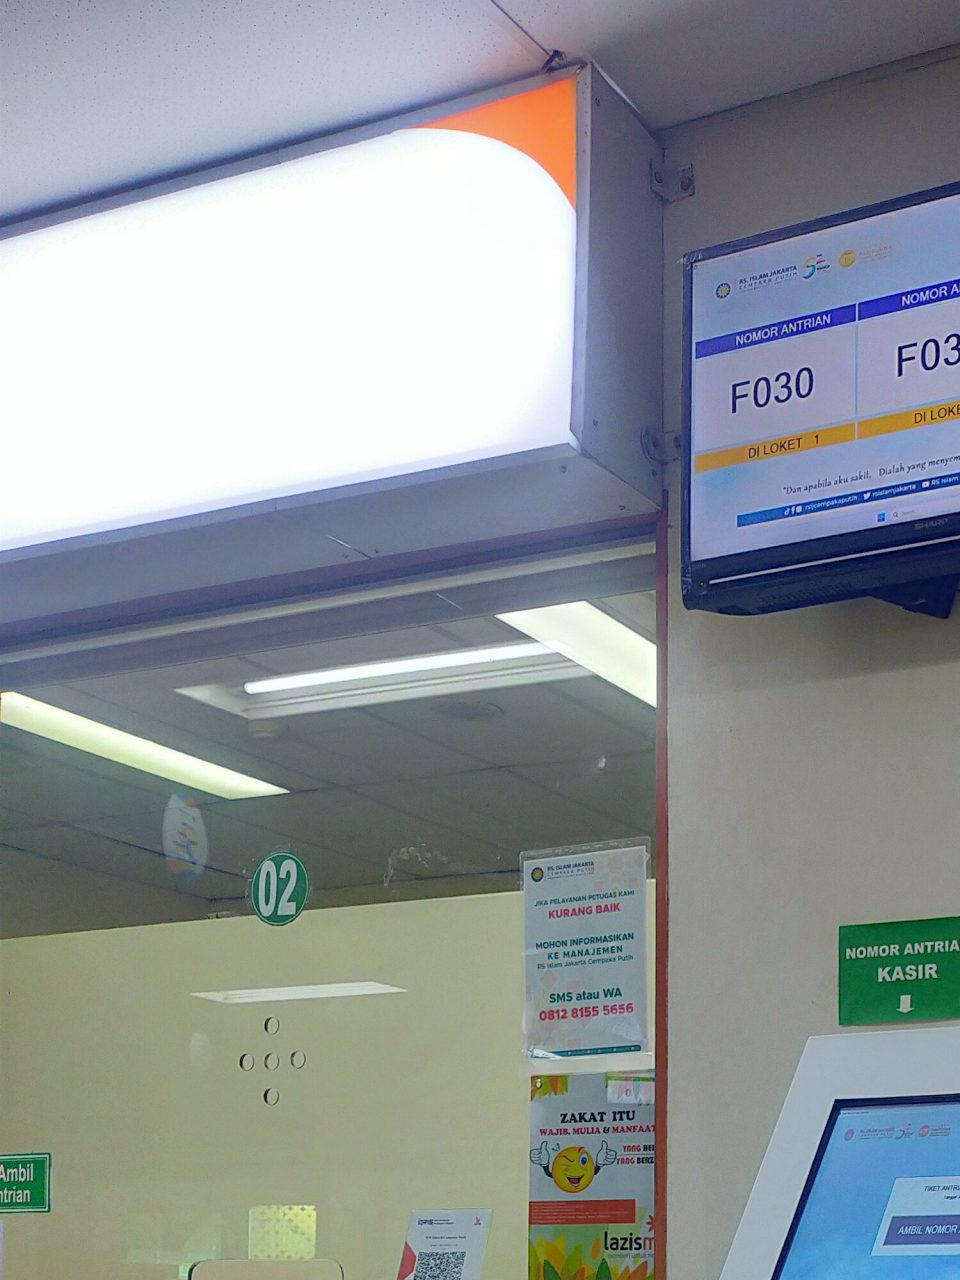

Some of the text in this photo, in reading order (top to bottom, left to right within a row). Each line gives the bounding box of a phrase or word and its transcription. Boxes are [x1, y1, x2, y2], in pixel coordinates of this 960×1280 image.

[769, 265, 797, 277] JAKARTA
[901, 285, 946, 306] NOMOR
[735, 314, 831, 345] NOMOR ANTRIAN
[731, 367, 814, 414] F030
[914, 412, 927, 424] DI
[748, 434, 820, 459] DI LOKET 1
[803, 478, 832, 494] apabila
[833, 475, 849, 486] aku
[879, 464, 905, 477] Dialah
[906, 461, 926, 474] yang
[931, 477, 940, 486] RS
[941, 474, 959, 484] Islam
[556, 863, 571, 871] ISLAM
[572, 861, 594, 869] JAKARTA
[258, 859, 297, 917] 02
[550, 895, 587, 905] PELAYANAN
[588, 892, 617, 901] PETUGAS
[548, 902, 620, 919] KURANG BAIK
[535, 932, 634, 950] MOHON INFORMASIKAN
[547, 945, 623, 960] KE MANAJEMEN
[845, 944, 900, 959] NOMOR
[547, 961, 563, 969] Islam
[564, 959, 587, 968] Jakarta
[588, 956, 616, 966] Cempaka
[617, 954, 634, 963] Putih
[877, 963, 938, 982] KASIR
[549, 987, 622, 1004] SMS atau WA
[539, 1003, 634, 1022] 0812 8155 5656
[560, 1110, 635, 1124] ZAKAT ITU
[572, 1126, 600, 1135] MULIA
[603, 1126, 610, 1134] &
[617, 1157, 635, 1165] YANG
[0, 1163, 34, 1182] Ambil
[897, 1225, 923, 1235] AMBIL
[925, 1225, 957, 1234] NOMOR
